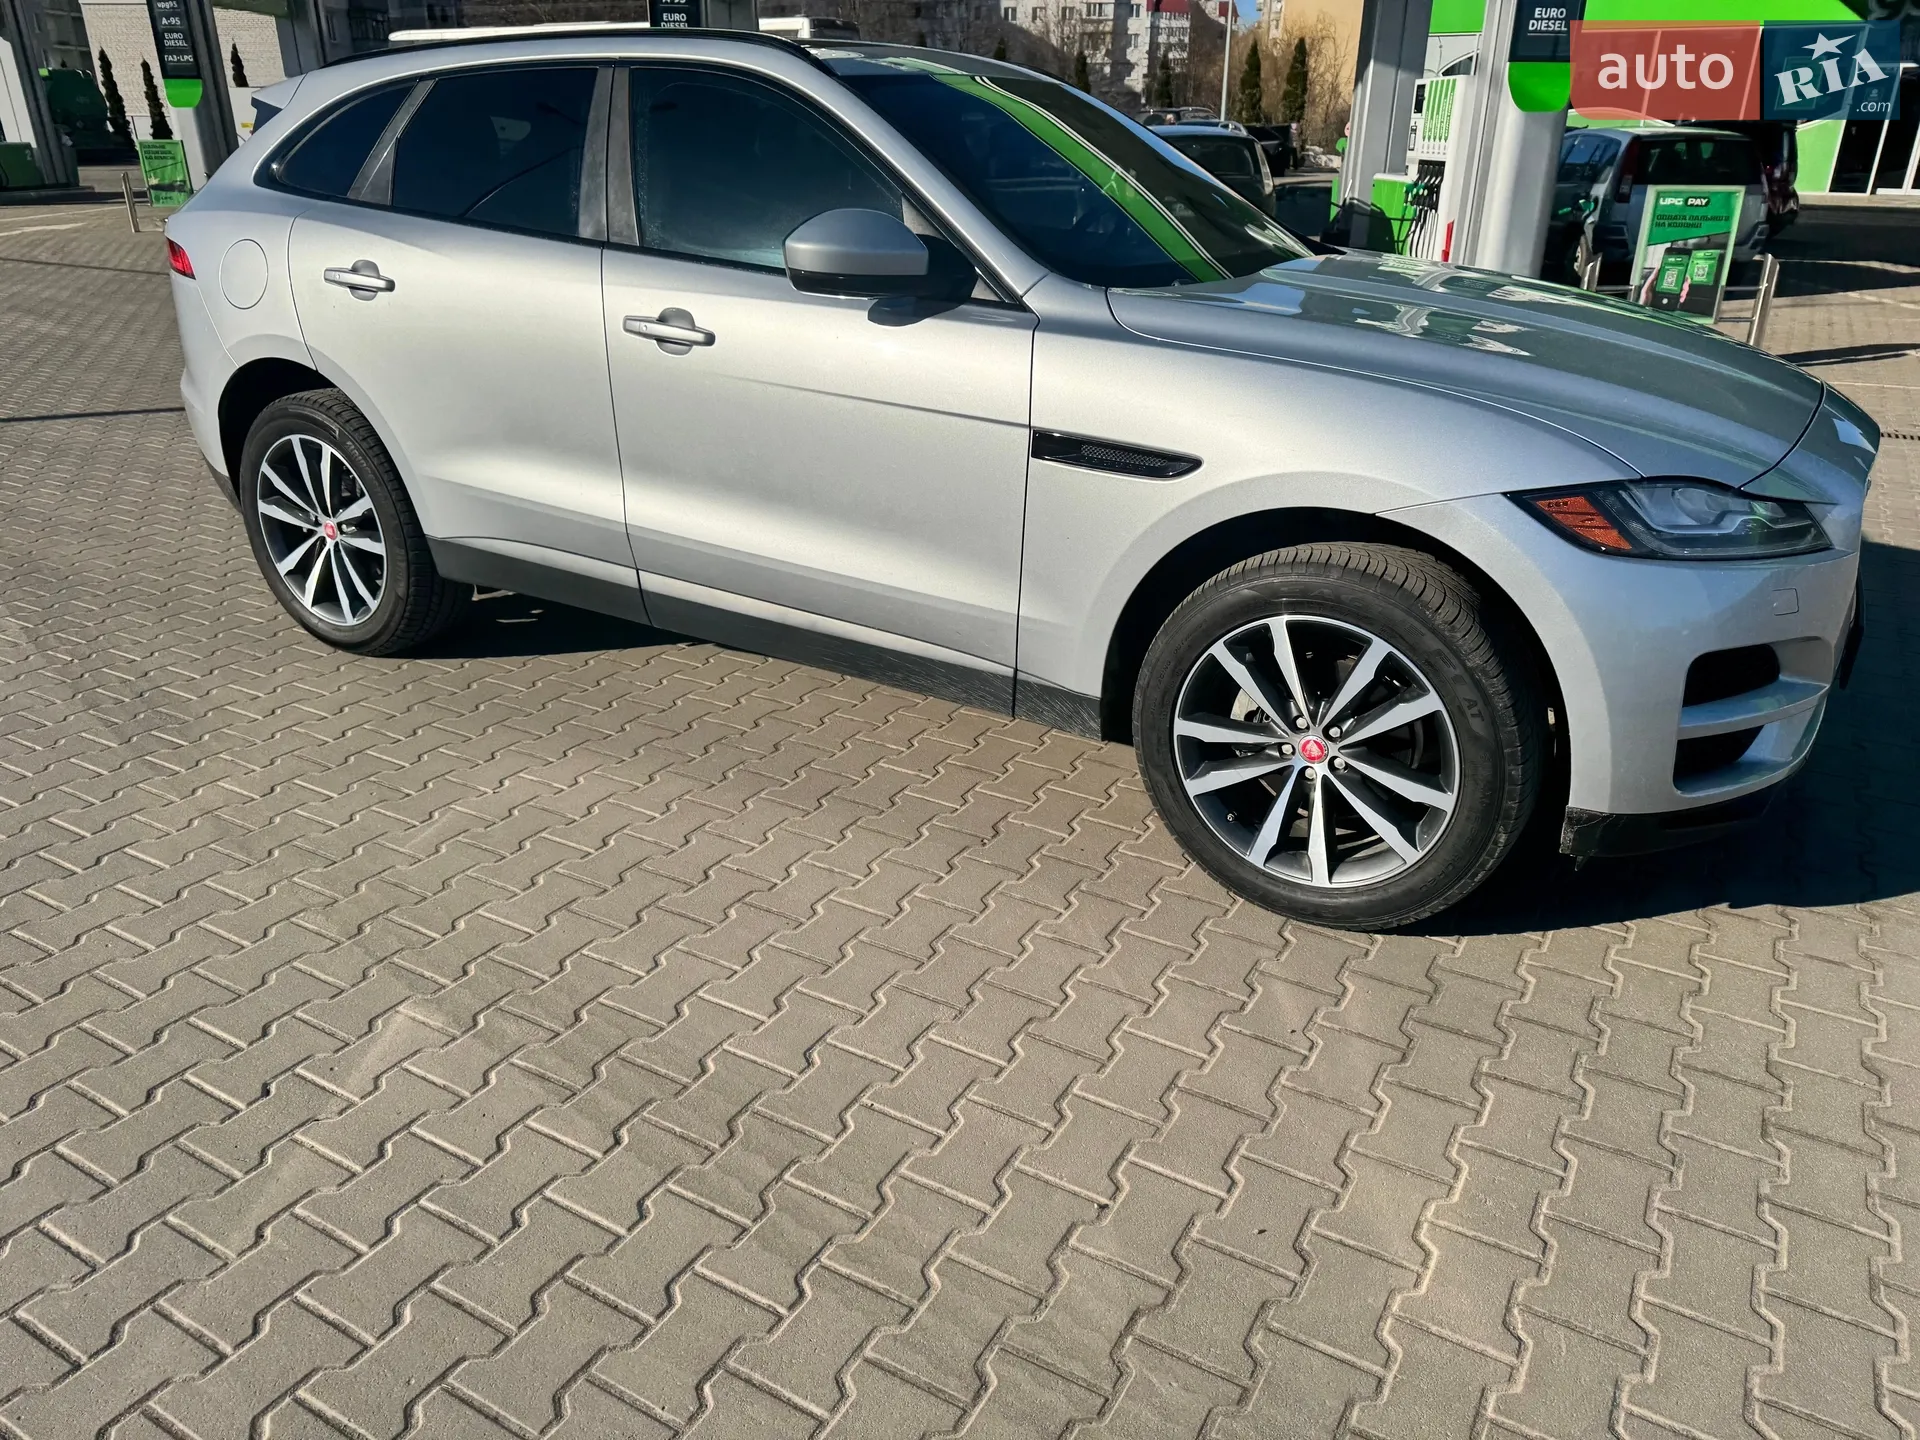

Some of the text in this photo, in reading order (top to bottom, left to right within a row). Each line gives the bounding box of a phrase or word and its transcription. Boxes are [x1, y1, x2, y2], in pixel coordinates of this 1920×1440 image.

[662, 12, 687, 21] EURO
[1534, 7, 1567, 19] EURO
[1528, 19, 1568, 31] DIESEL
[164, 39, 188, 47] DIESEL
[1660, 197, 1708, 206] UPG PAY
